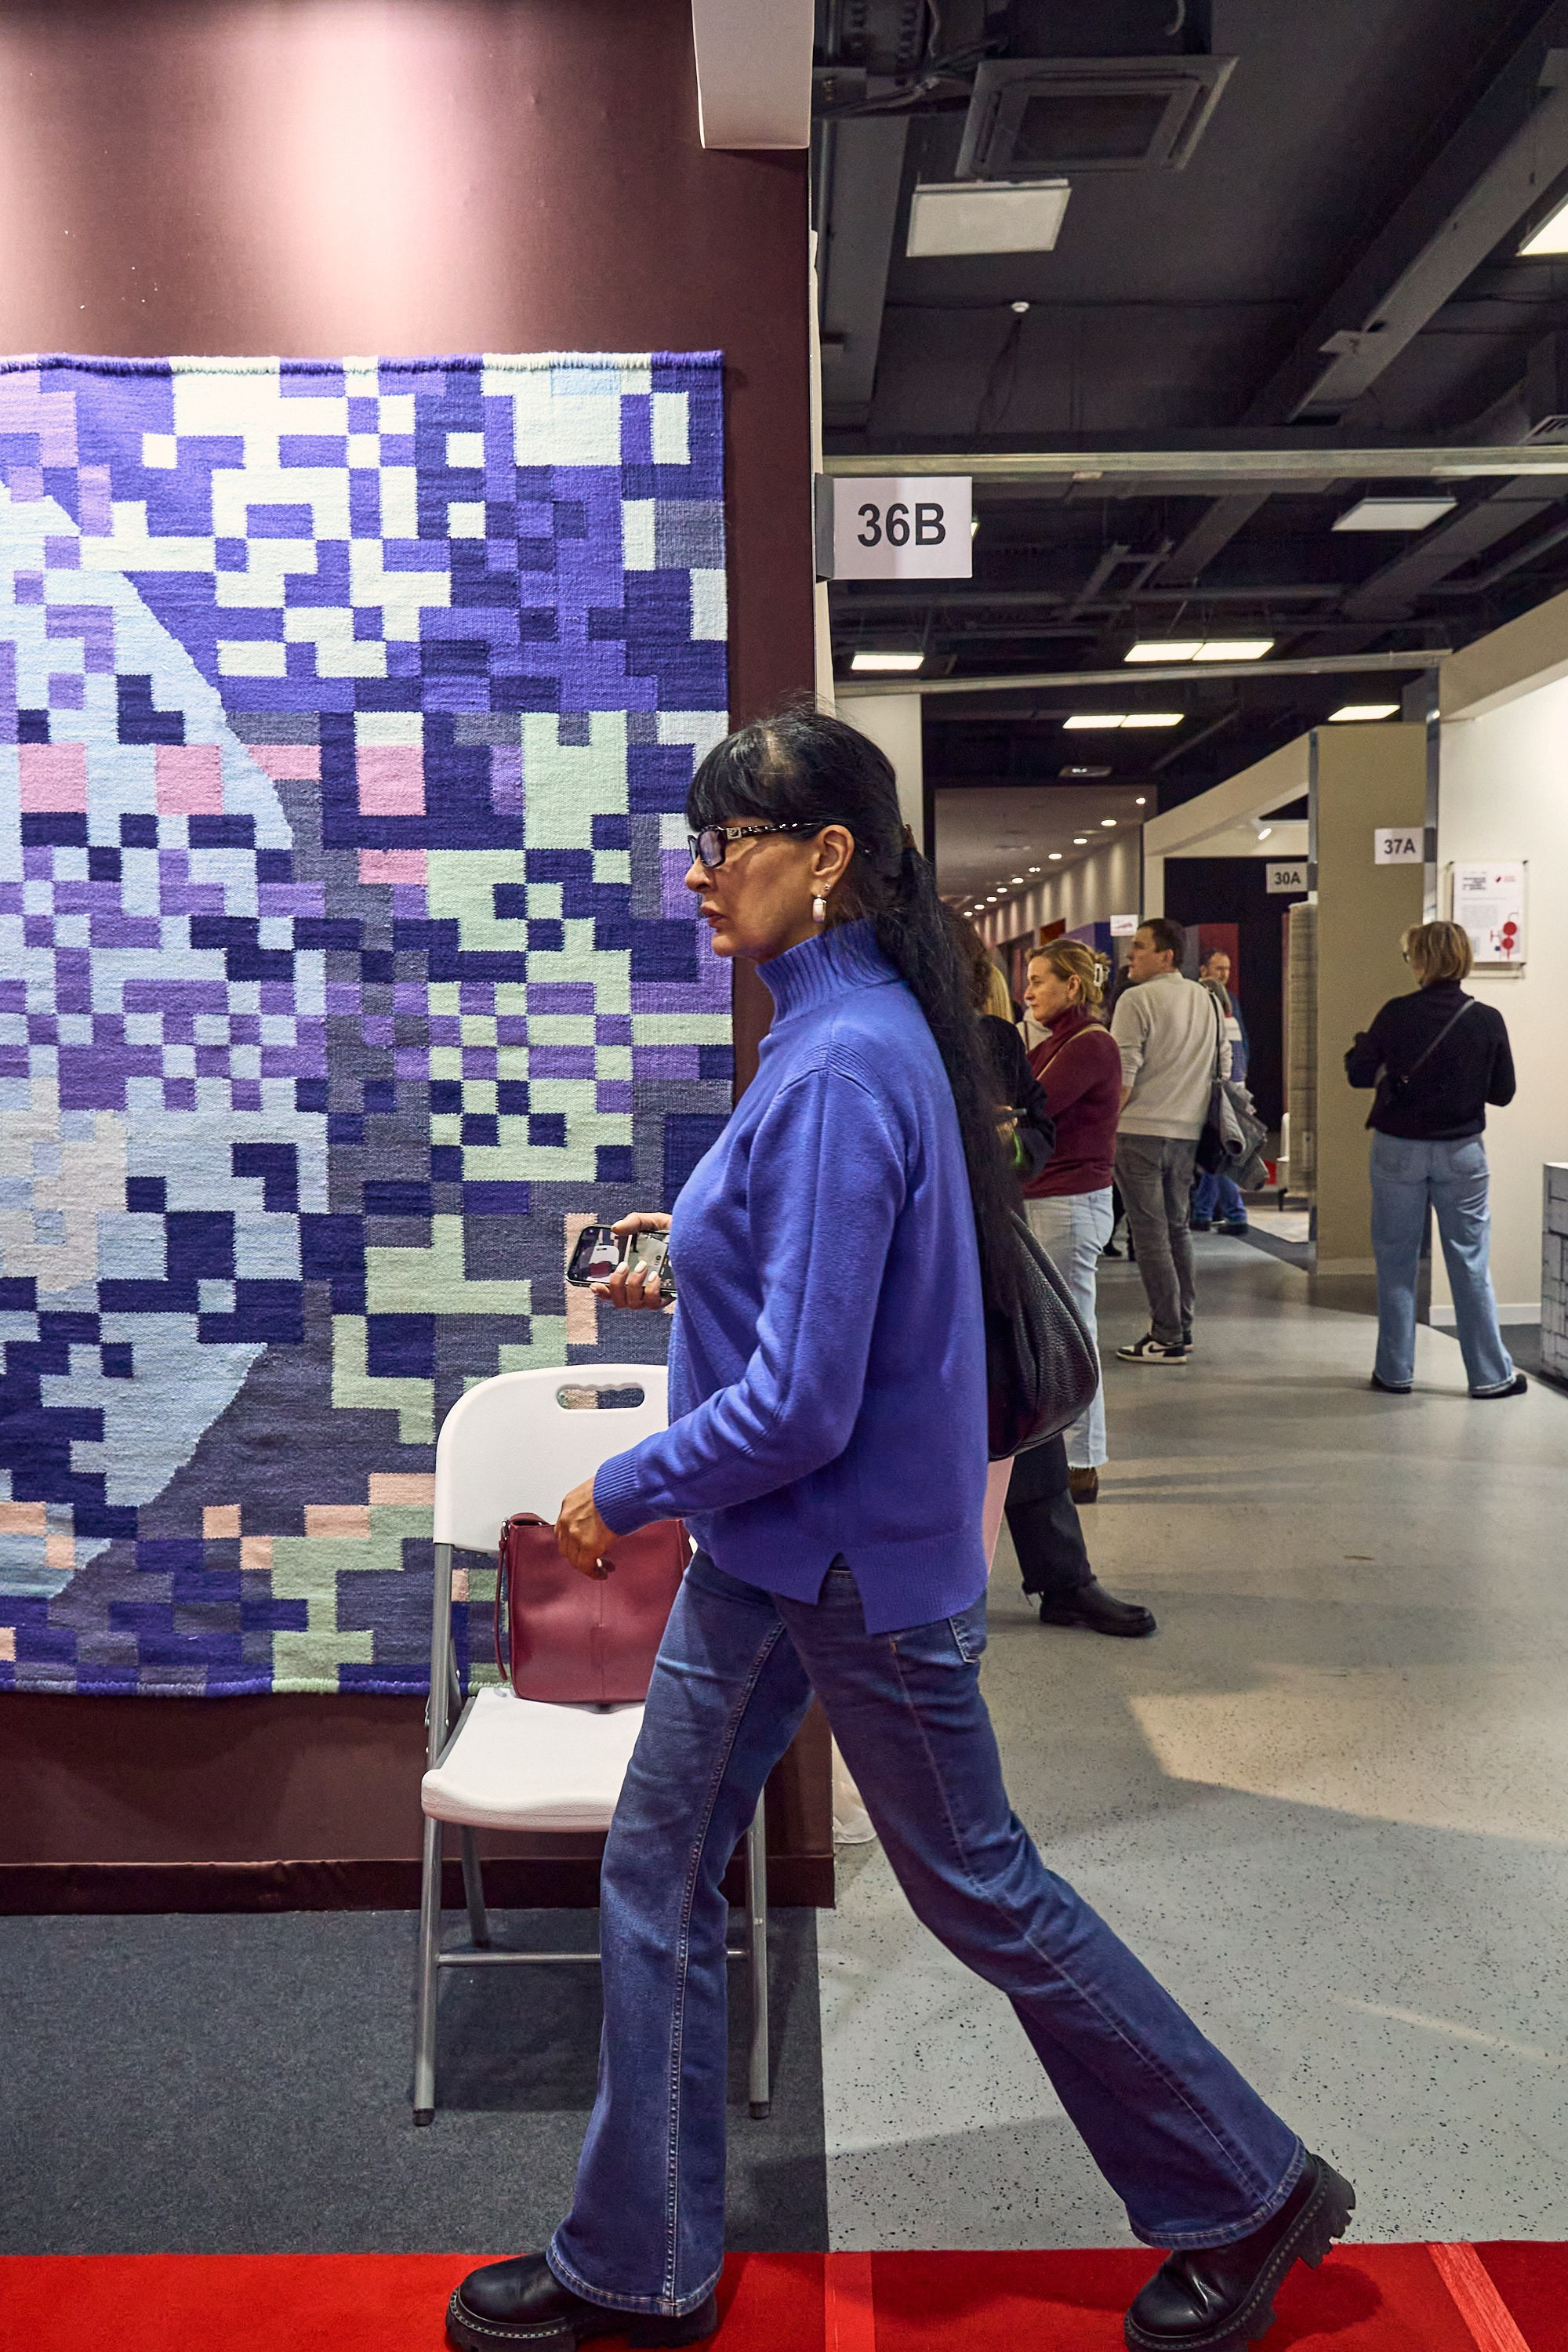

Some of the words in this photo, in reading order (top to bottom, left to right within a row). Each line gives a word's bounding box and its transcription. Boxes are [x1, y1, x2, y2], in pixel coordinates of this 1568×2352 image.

[858, 503, 946, 547] 36B
[1384, 838, 1416, 855] 37A
[1274, 872, 1301, 885] 30A
